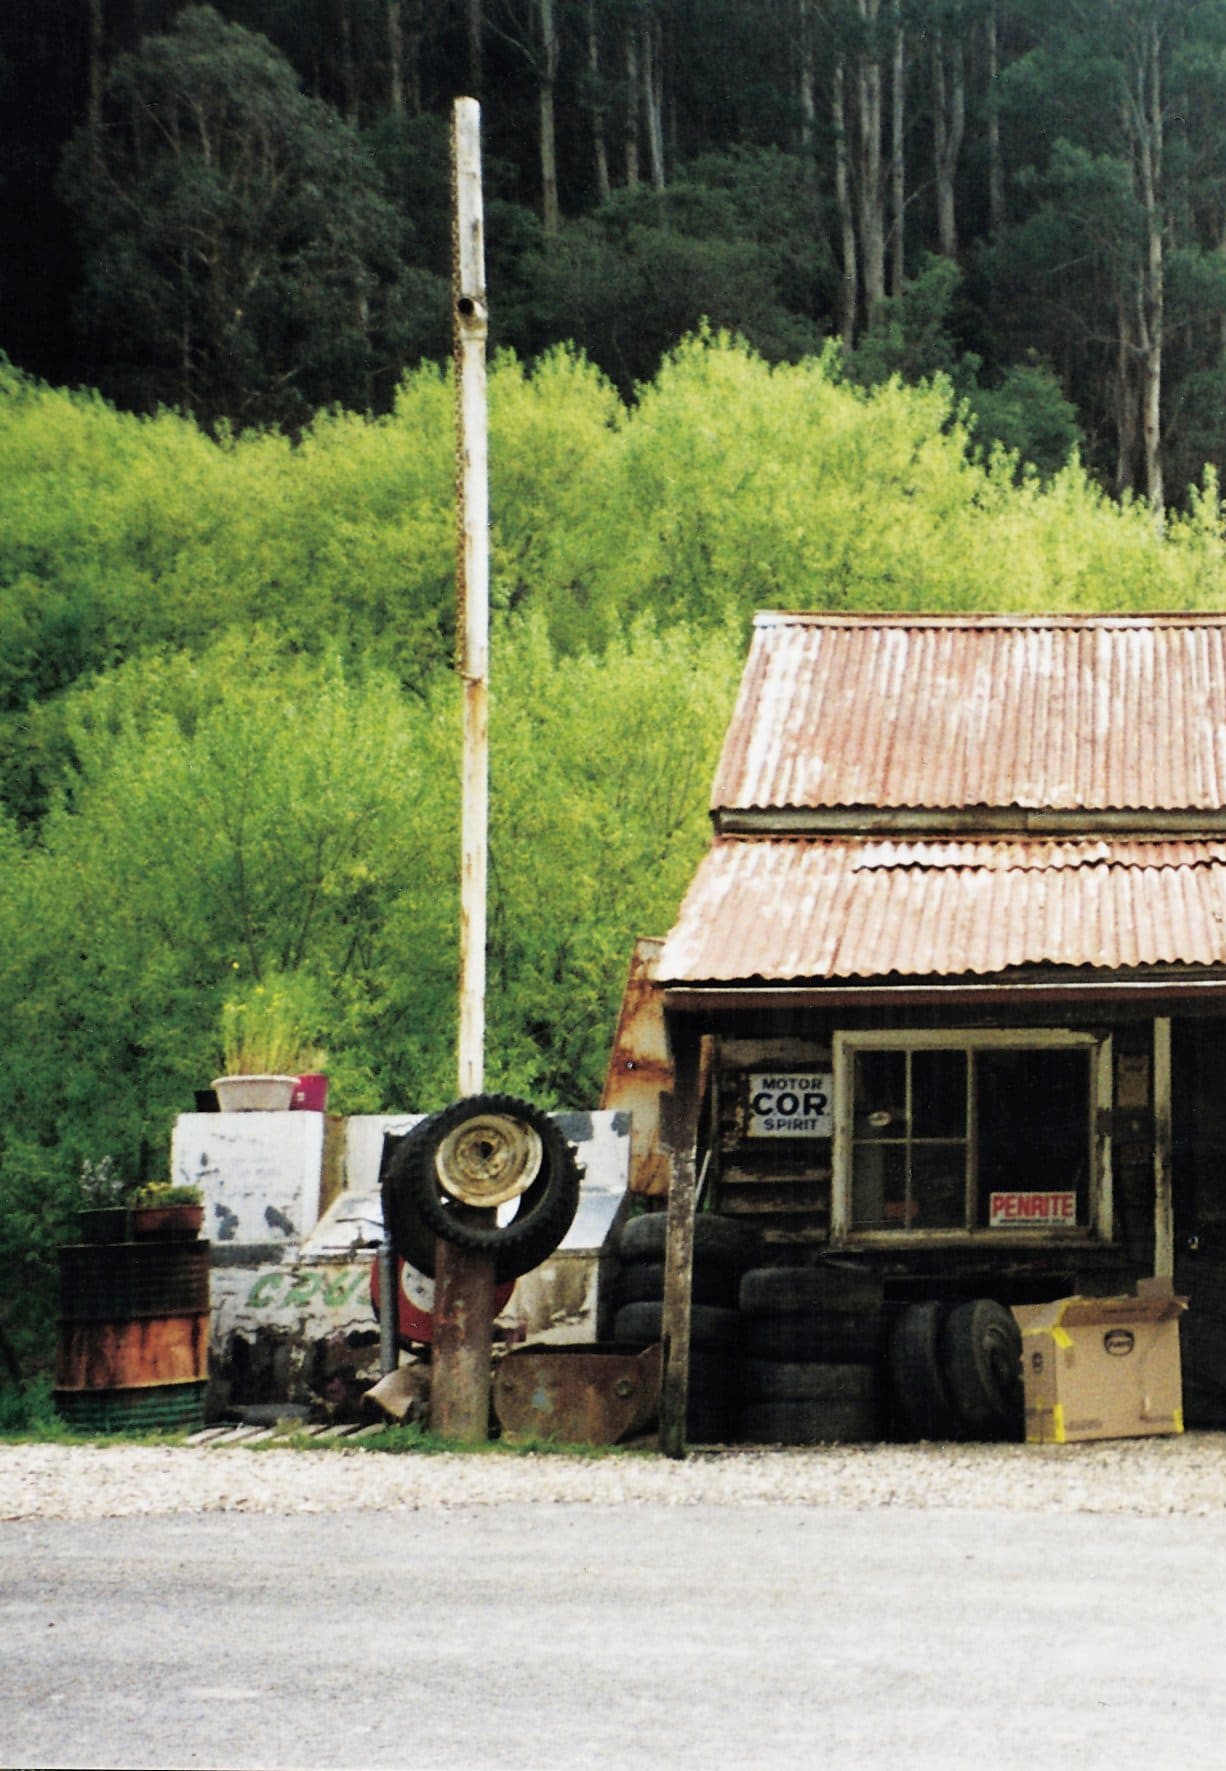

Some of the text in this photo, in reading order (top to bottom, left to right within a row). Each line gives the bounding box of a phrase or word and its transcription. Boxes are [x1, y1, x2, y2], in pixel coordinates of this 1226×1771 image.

[763, 1078, 823, 1090] MOTOR
[753, 1092, 827, 1116] COR
[764, 1118, 819, 1130] SPIRIT
[992, 1194, 1074, 1217] PENRITE
